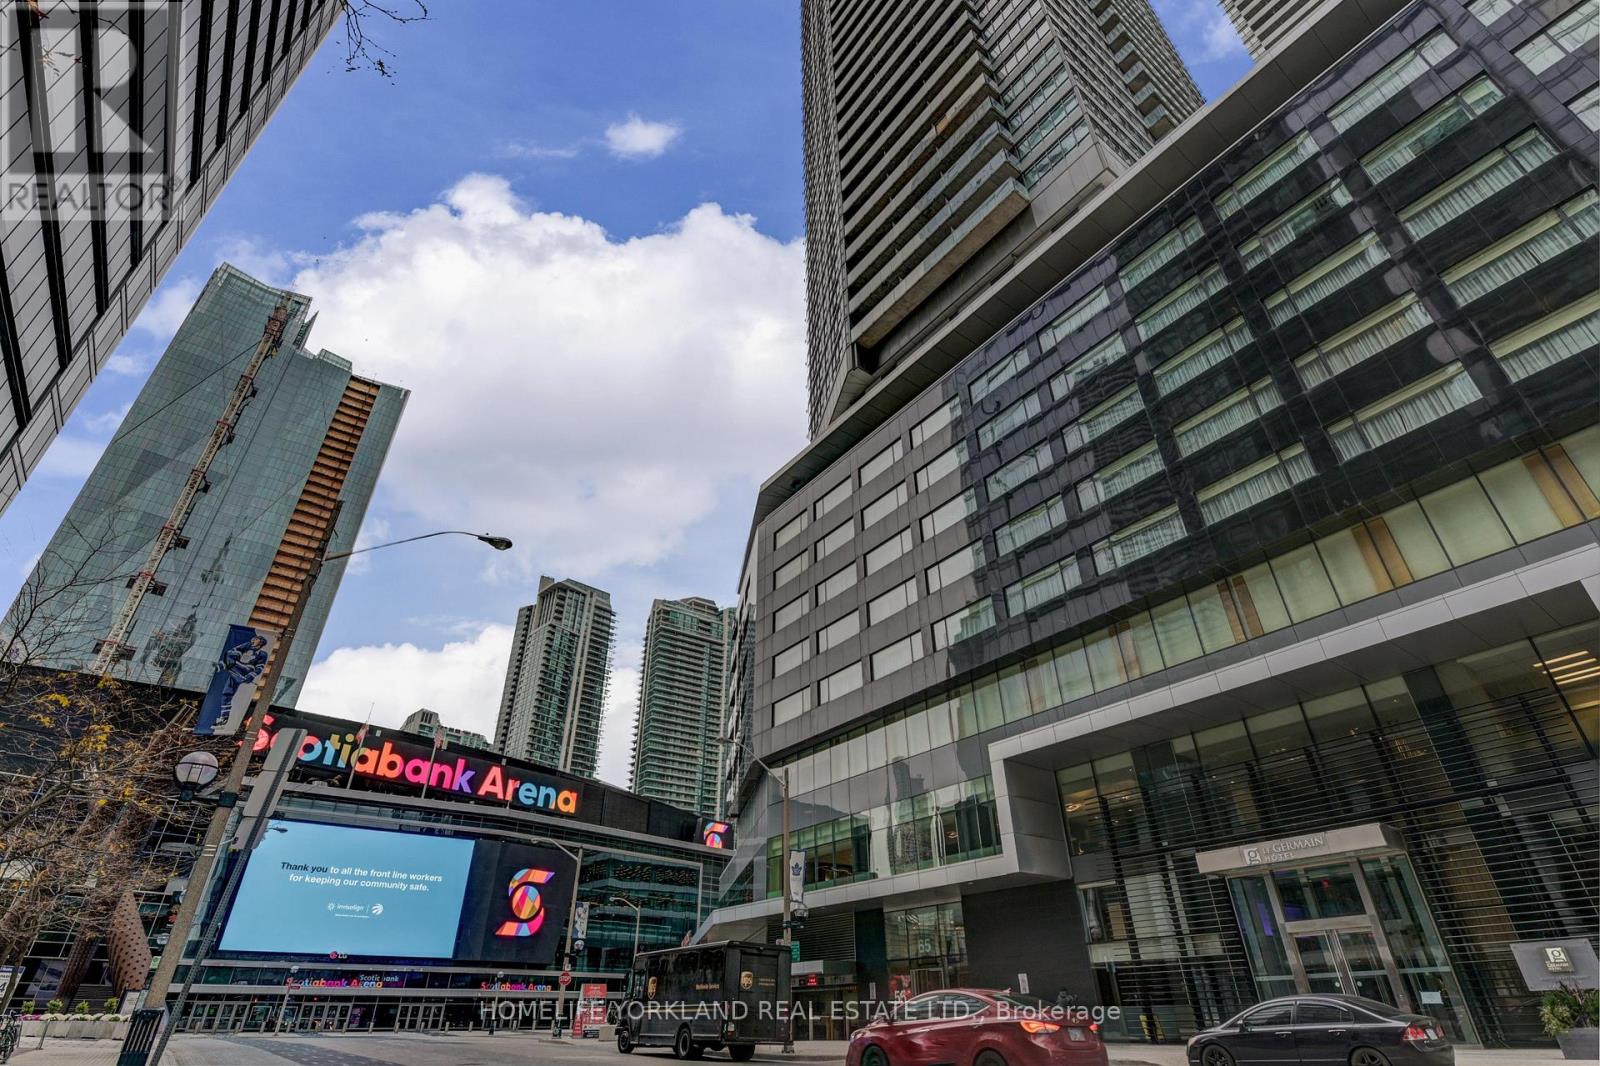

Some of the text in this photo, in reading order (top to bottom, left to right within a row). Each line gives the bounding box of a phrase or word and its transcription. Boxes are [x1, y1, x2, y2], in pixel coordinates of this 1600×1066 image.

[237, 713, 578, 813] Sotiabank Arena
[1272, 838, 1324, 853] GERMAIN
[281, 862, 309, 871] Thank
[330, 866, 339, 874] to
[341, 867, 352, 875] all
[354, 868, 368, 876] the
[370, 869, 390, 878] front
[392, 871, 407, 879] line
[409, 873, 443, 882] workers
[289, 874, 303, 882] for
[305, 875, 340, 886] keeping
[360, 880, 407, 891] community
[409, 883, 430, 891] safe.
